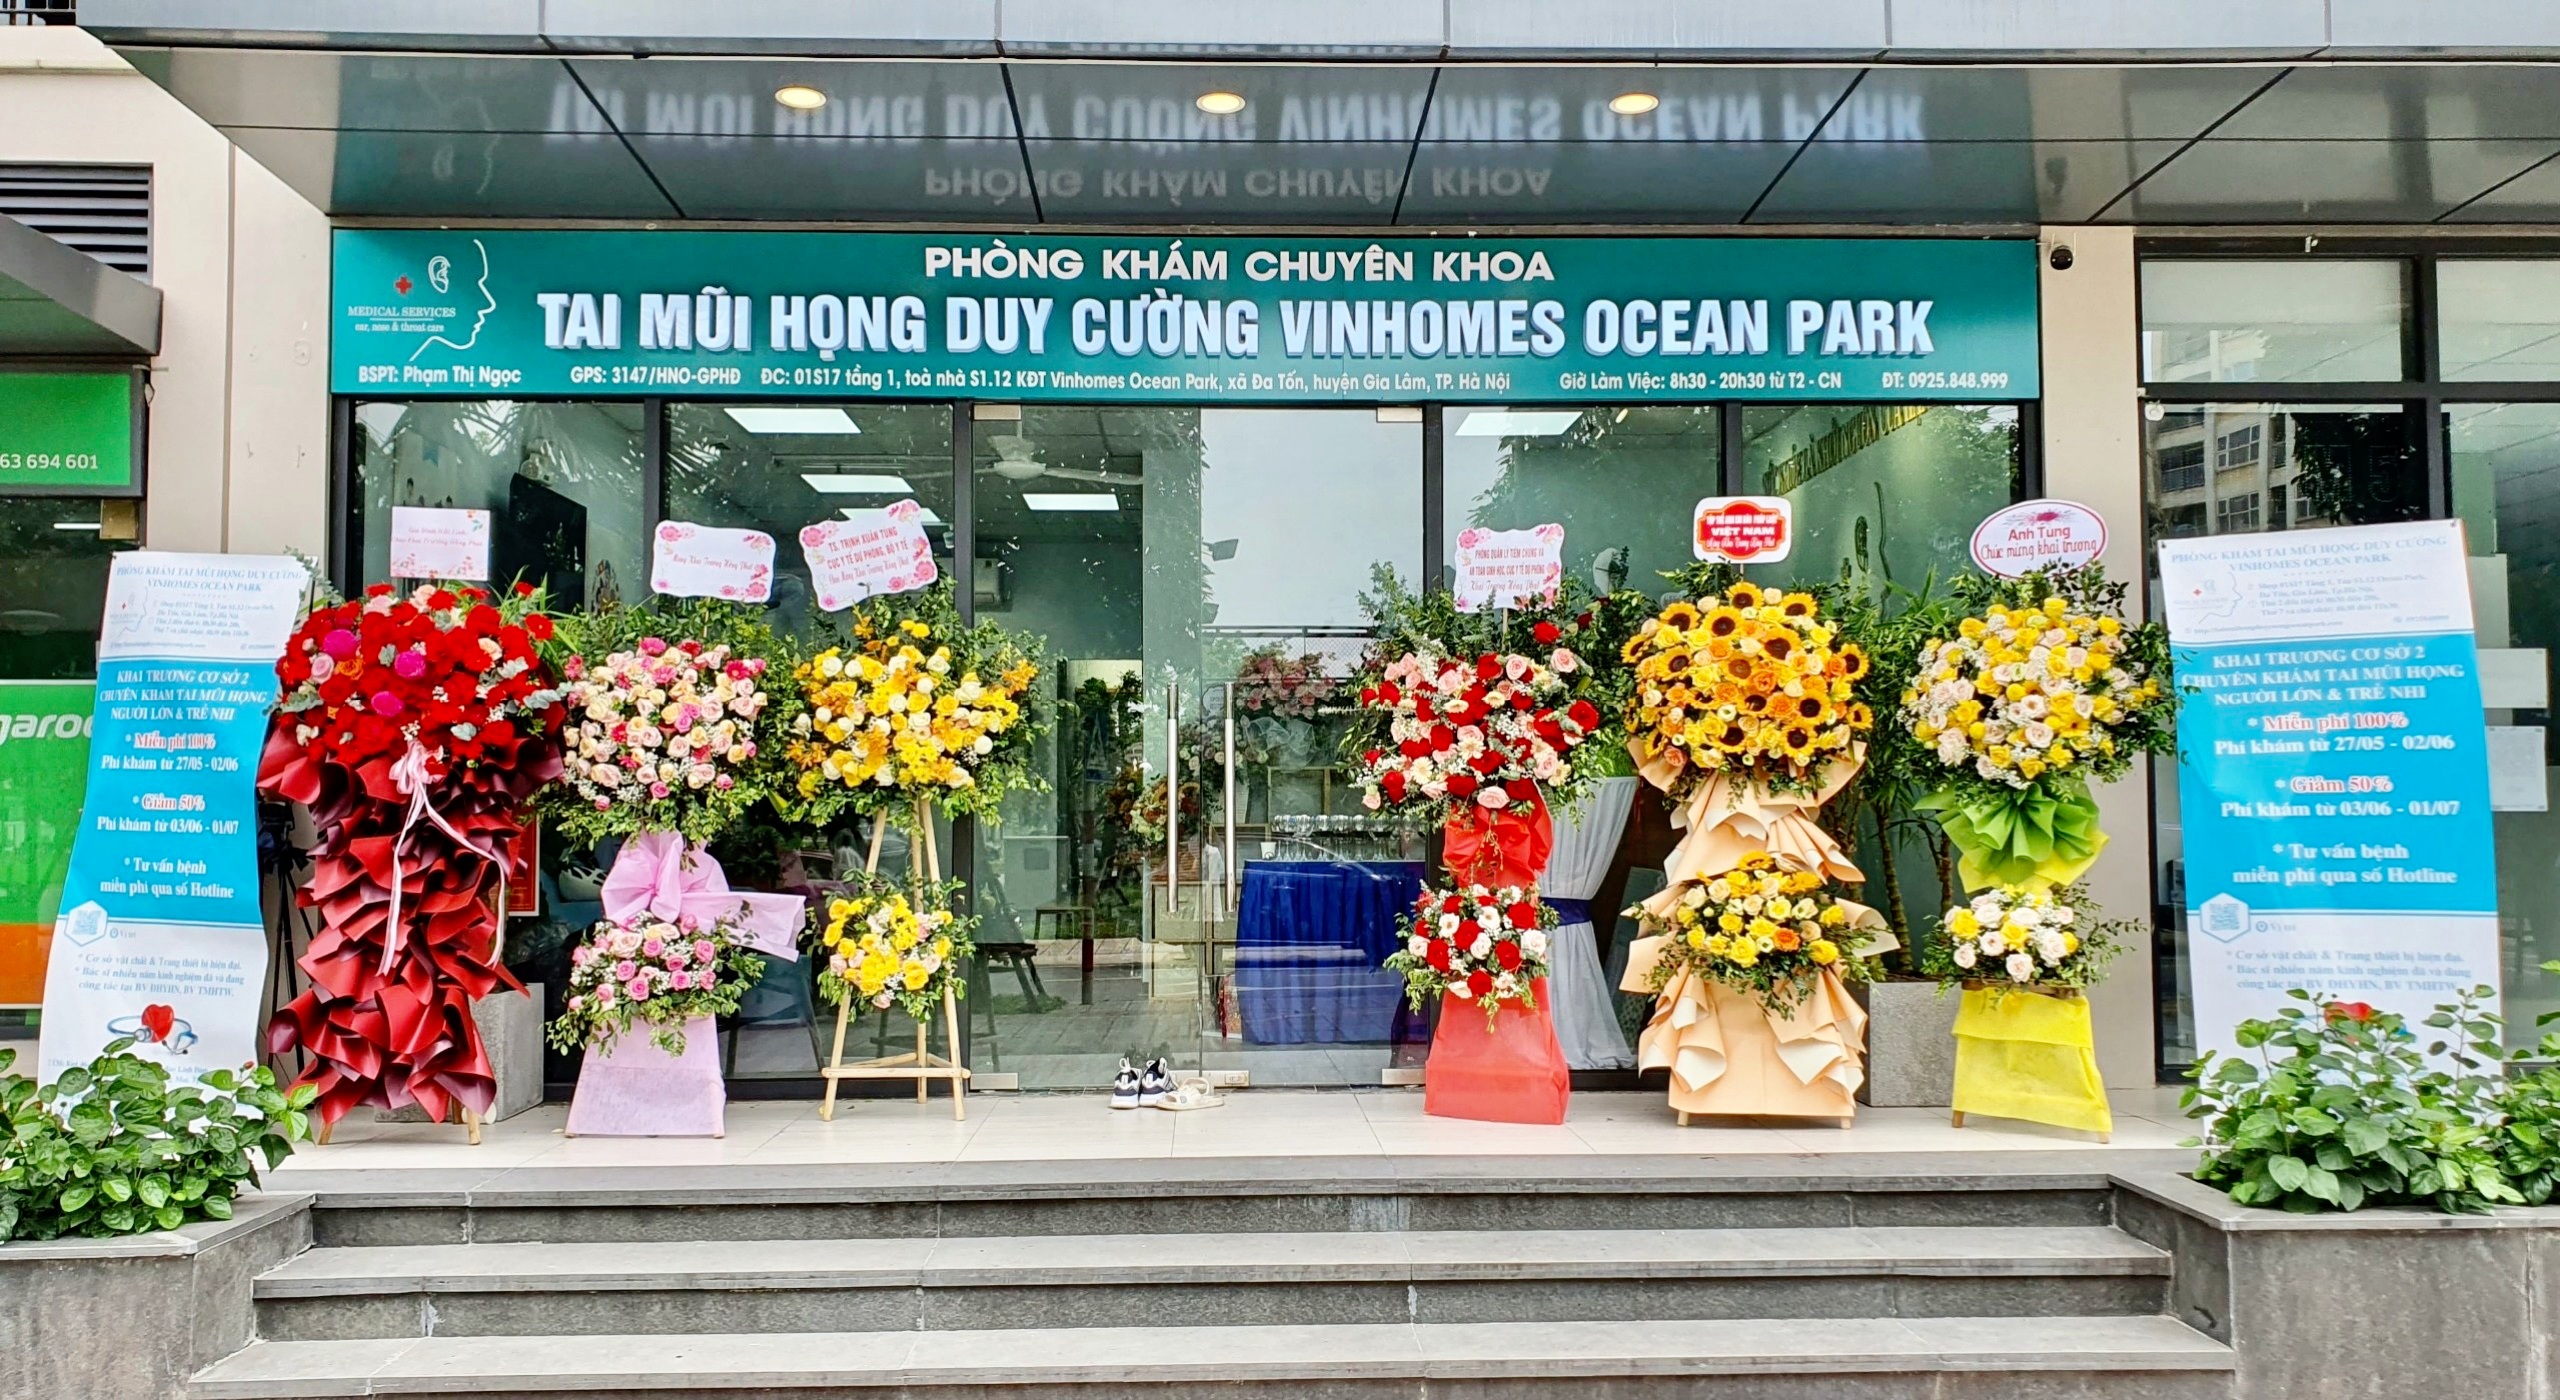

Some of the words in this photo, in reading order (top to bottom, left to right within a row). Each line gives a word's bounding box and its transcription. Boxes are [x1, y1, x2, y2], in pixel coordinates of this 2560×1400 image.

[924, 238, 1083, 281] PHÒNG
[1102, 240, 1228, 282] KHÁM
[1244, 244, 1414, 283] CHUYÊN
[1432, 251, 1554, 283] KHOA
[348, 306, 399, 316] MEDICAL
[402, 307, 456, 317] SERVICES
[355, 324, 370, 332] ear,
[372, 323, 390, 331] nose
[392, 322, 399, 331] &
[400, 322, 426, 332] throat
[427, 324, 444, 332] care
[537, 293, 622, 350] TAI
[639, 286, 753, 352] MŨI
[769, 293, 926, 361] HỌNG
[944, 297, 1052, 354] DUY
[1070, 286, 1259, 356] CƯỜNG
[1279, 299, 1566, 357] VINHOMES
[1583, 299, 1771, 357] OCEAN
[1786, 300, 1936, 358] PARK
[358, 366, 398, 383] BSPT:
[403, 366, 448, 387] Phạm
[452, 366, 475, 387] Thị
[479, 366, 521, 387] Ngọc
[570, 366, 607, 384] GPS:
[612, 366, 741, 386] 3147/HNO-GPHĐ
[761, 368, 790, 385] ĐC:
[794, 368, 840, 386] 01S17
[845, 364, 883, 390] tầng
[887, 369, 901, 389] 1,
[905, 367, 932, 388] toà
[936, 368, 966, 388] nhà
[970, 370, 1012, 388] S1.12
[1016, 371, 1047, 388] KĐT
[1050, 372, 1125, 389] Vinhomes
[1129, 372, 1181, 390] Ocean
[1185, 372, 1223, 393] Park,
[1228, 374, 1247, 390] xã
[1251, 373, 1273, 390] Đa
[1278, 369, 1308, 392] Tốn,
[1313, 373, 1359, 395] huyện
[1363, 373, 1390, 390] Gia
[1395, 372, 1431, 393] Lâm,
[1436, 373, 1453, 390] TP.
[1459, 372, 1480, 390] Hà
[1485, 372, 1510, 395] Nội
[1559, 371, 1586, 390] Giờ
[1591, 371, 1624, 389] Làm
[1627, 371, 1666, 395] Việc:
[1670, 372, 1706, 390] 8h30
[1719, 372, 1766, 390] 20h30
[1770, 371, 1785, 389] từ
[1789, 373, 1805, 389] T2
[1818, 372, 1842, 390] CN
[1881, 373, 1905, 389] ĐT:
[1908, 372, 2008, 390] 0925.848.999
[0, 453, 22, 471] 63
[26, 455, 61, 471] 694
[65, 455, 98, 471] 601
[1711, 526, 1740, 537] VIỆT
[1742, 526, 1775, 536] NAM
[2008, 529, 2034, 541] Anh
[1981, 543, 2005, 560] Chúc
[2037, 538, 2060, 555] khai
[2213, 652, 2262, 669] KHAI
[2351, 646, 2381, 662] CƠ
[2384, 643, 2412, 661] SỞ
[2415, 645, 2425, 660] 2
[117, 670, 143, 683] KHAI
[198, 671, 219, 684] CƠ
[219, 669, 239, 684] SỞ
[240, 671, 249, 685] 2
[2181, 667, 2259, 689] CHUYÊN
[2262, 665, 2321, 686] KHÁM
[2325, 668, 2360, 683] TAI
[2363, 664, 2402, 681] MŨI
[2406, 664, 2466, 684] HỌNG
[100, 688, 138, 701] CHUYÊN
[141, 688, 174, 700] KHÁM
[176, 689, 199, 701] TAI
[200, 688, 225, 702] MŨI
[228, 691, 267, 705] HỌNG
[2214, 688, 2278, 706] NGƯỜI
[2280, 685, 2323, 704] LỚN
[2325, 687, 2343, 702] &
[2344, 682, 2386, 701] TRẺ
[2390, 684, 2427, 700] NHI
[151, 706, 174, 720] LỚN
[175, 708, 183, 719] &
[186, 703, 209, 720] TRẺ
[210, 708, 235, 721] NHI
[2262, 713, 2313, 733] Miễn
[2316, 714, 2349, 734] phí
[2352, 712, 2410, 729] 100%
[134, 730, 166, 749] Miễn
[168, 733, 186, 752] phí
[187, 733, 216, 750] 100%
[2214, 739, 2247, 756] Phí
[2250, 738, 2306, 754] khám
[2308, 737, 2331, 752] từ
[2333, 737, 2386, 752] 27/05
[2401, 735, 2457, 751] 02/06
[101, 755, 120, 769] Phí
[122, 755, 157, 770] khám
[160, 757, 174, 770] từ
[175, 756, 204, 771] 27/05
[211, 757, 239, 772] 02/06
[2290, 775, 2346, 793] Giảm
[2348, 775, 2394, 793] 50%
[141, 793, 177, 810] Giảm
[178, 795, 206, 812] 50%
[2221, 802, 2253, 818] Phí
[2256, 801, 2312, 818] khám
[2314, 802, 2337, 817] từ
[2339, 801, 2393, 816] 03/06
[2408, 800, 2462, 816] 01/07
[97, 816, 117, 831] Phí
[119, 817, 151, 832] khám
[154, 818, 169, 832] từ
[170, 818, 204, 833] 03/06
[212, 821, 240, 835] 01/07
[2288, 843, 2318, 860] Tư
[2320, 843, 2357, 860] vấn
[2360, 843, 2411, 862] bệnh
[133, 857, 150, 872] Tư
[153, 858, 174, 873] vấn
[176, 859, 207, 877] bệnh
[2232, 866, 2282, 884] miễn
[2284, 867, 2317, 886] phí
[2319, 870, 2358, 886] qua
[2361, 866, 2383, 884] số
[2387, 867, 2459, 885] Hotline
[100, 876, 127, 893] miễn
[129, 880, 149, 897] phí
[151, 882, 173, 898] qua
[175, 881, 189, 896] số
[190, 882, 235, 899] Hotline
